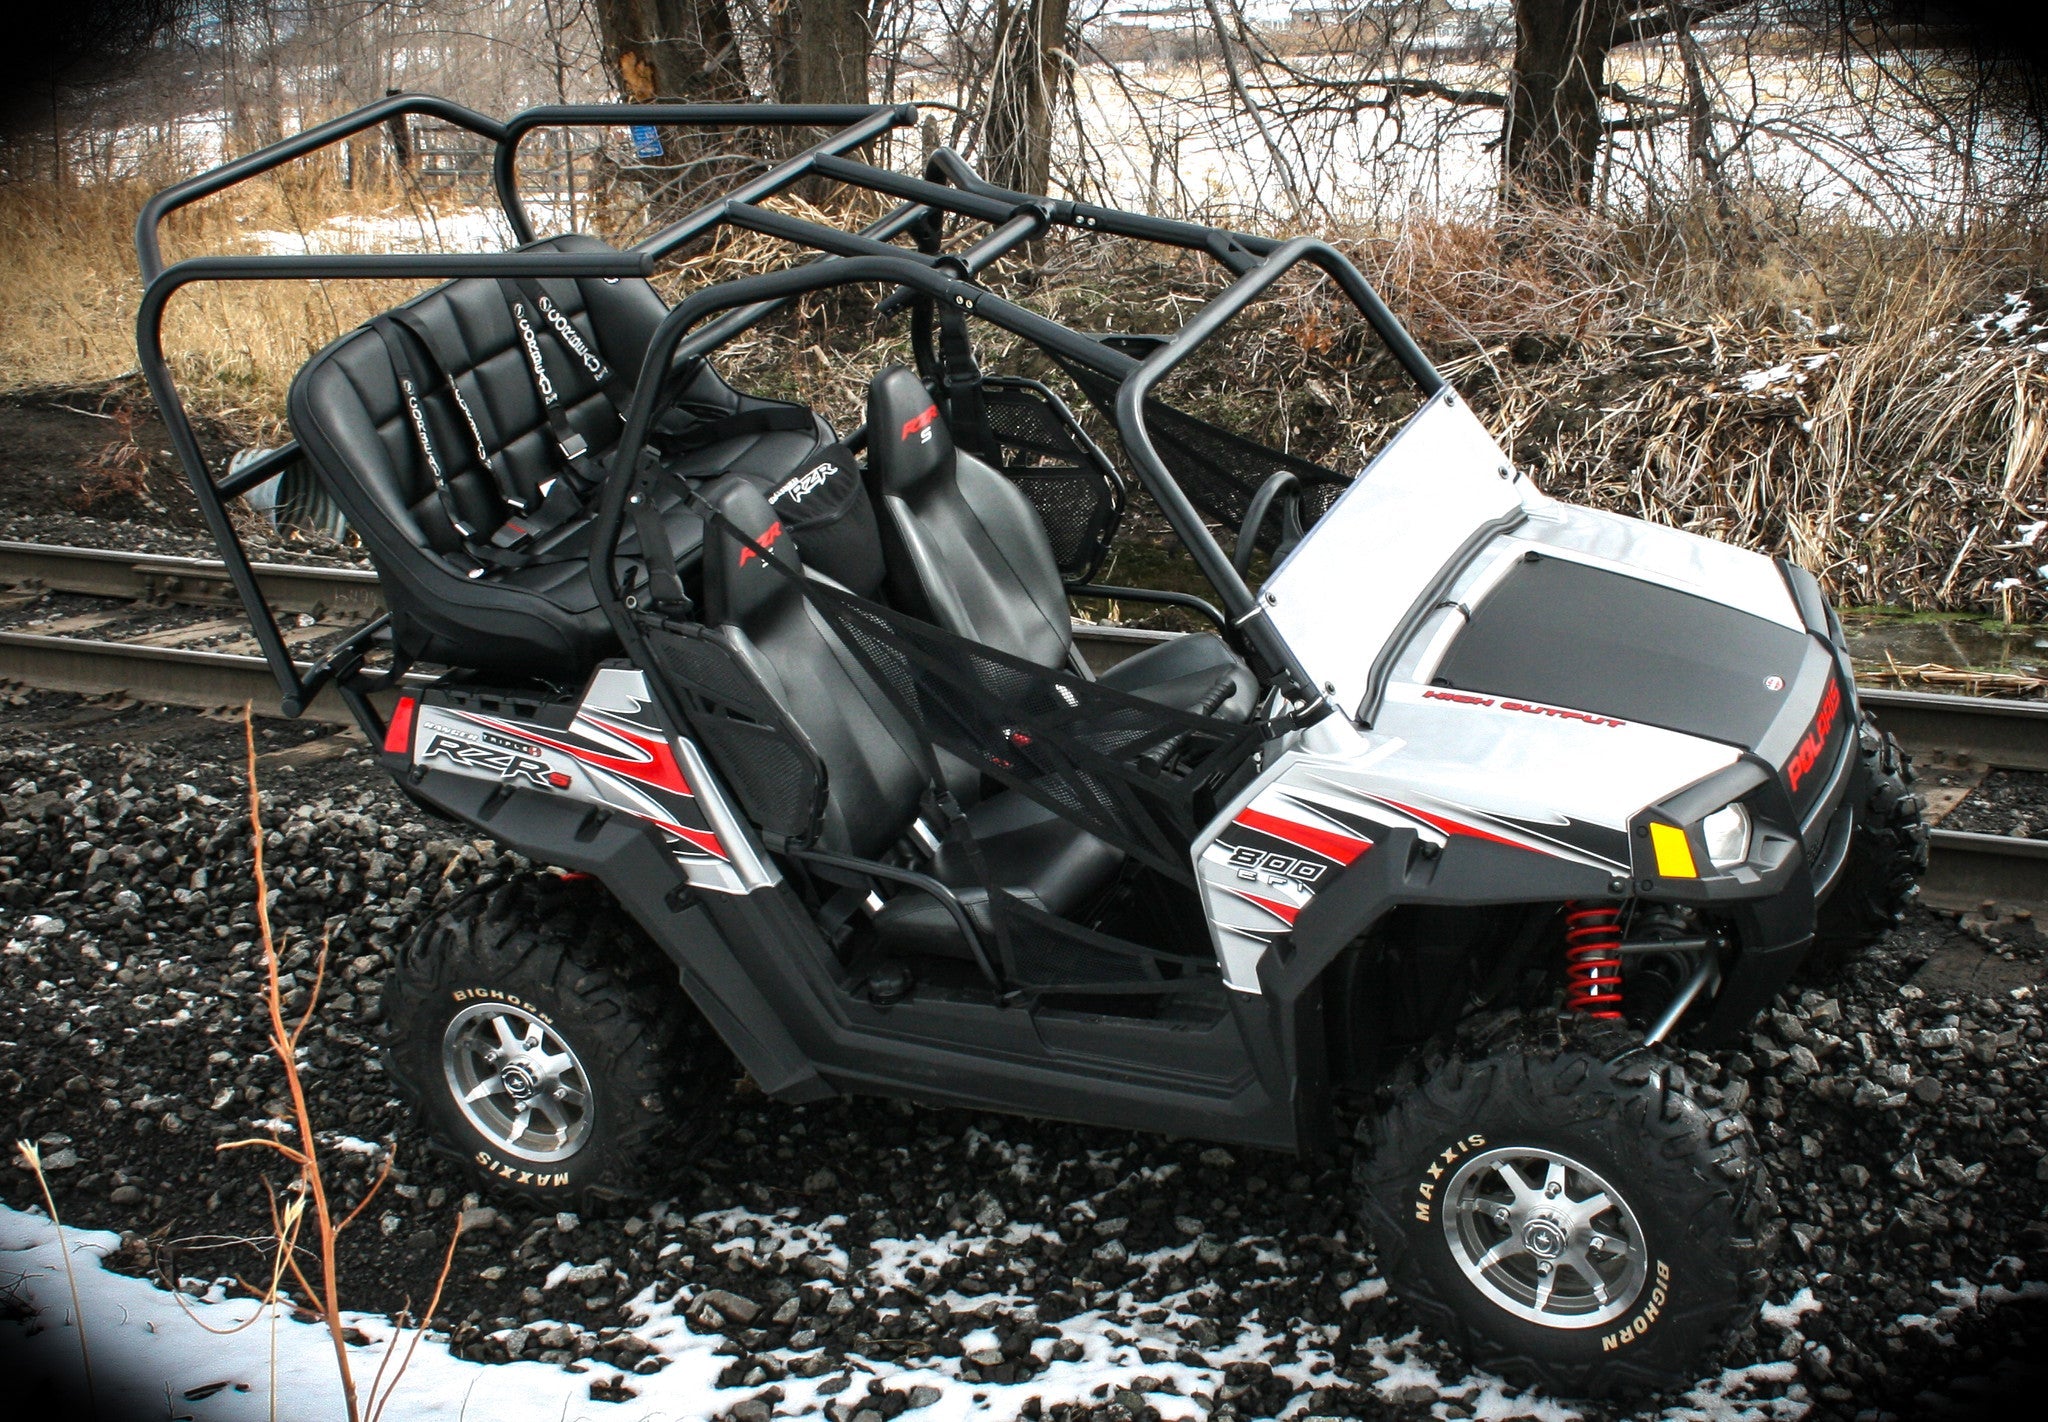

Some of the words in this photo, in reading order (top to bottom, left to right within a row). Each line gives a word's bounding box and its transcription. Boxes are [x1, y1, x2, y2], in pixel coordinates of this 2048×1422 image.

[787, 462, 839, 504] RZR
[1421, 690, 1495, 707] HIGH
[1500, 701, 1626, 728] OUTPUT
[423, 721, 479, 742] RANGER
[1787, 677, 1841, 793] POLARIS
[1227, 845, 1328, 882] 800
[451, 987, 554, 1026] BIGHORN
[474, 1150, 570, 1188] MAXXIS
[1414, 1133, 1488, 1223] MAXXIS
[1601, 1259, 1671, 1353] BIGHORN
